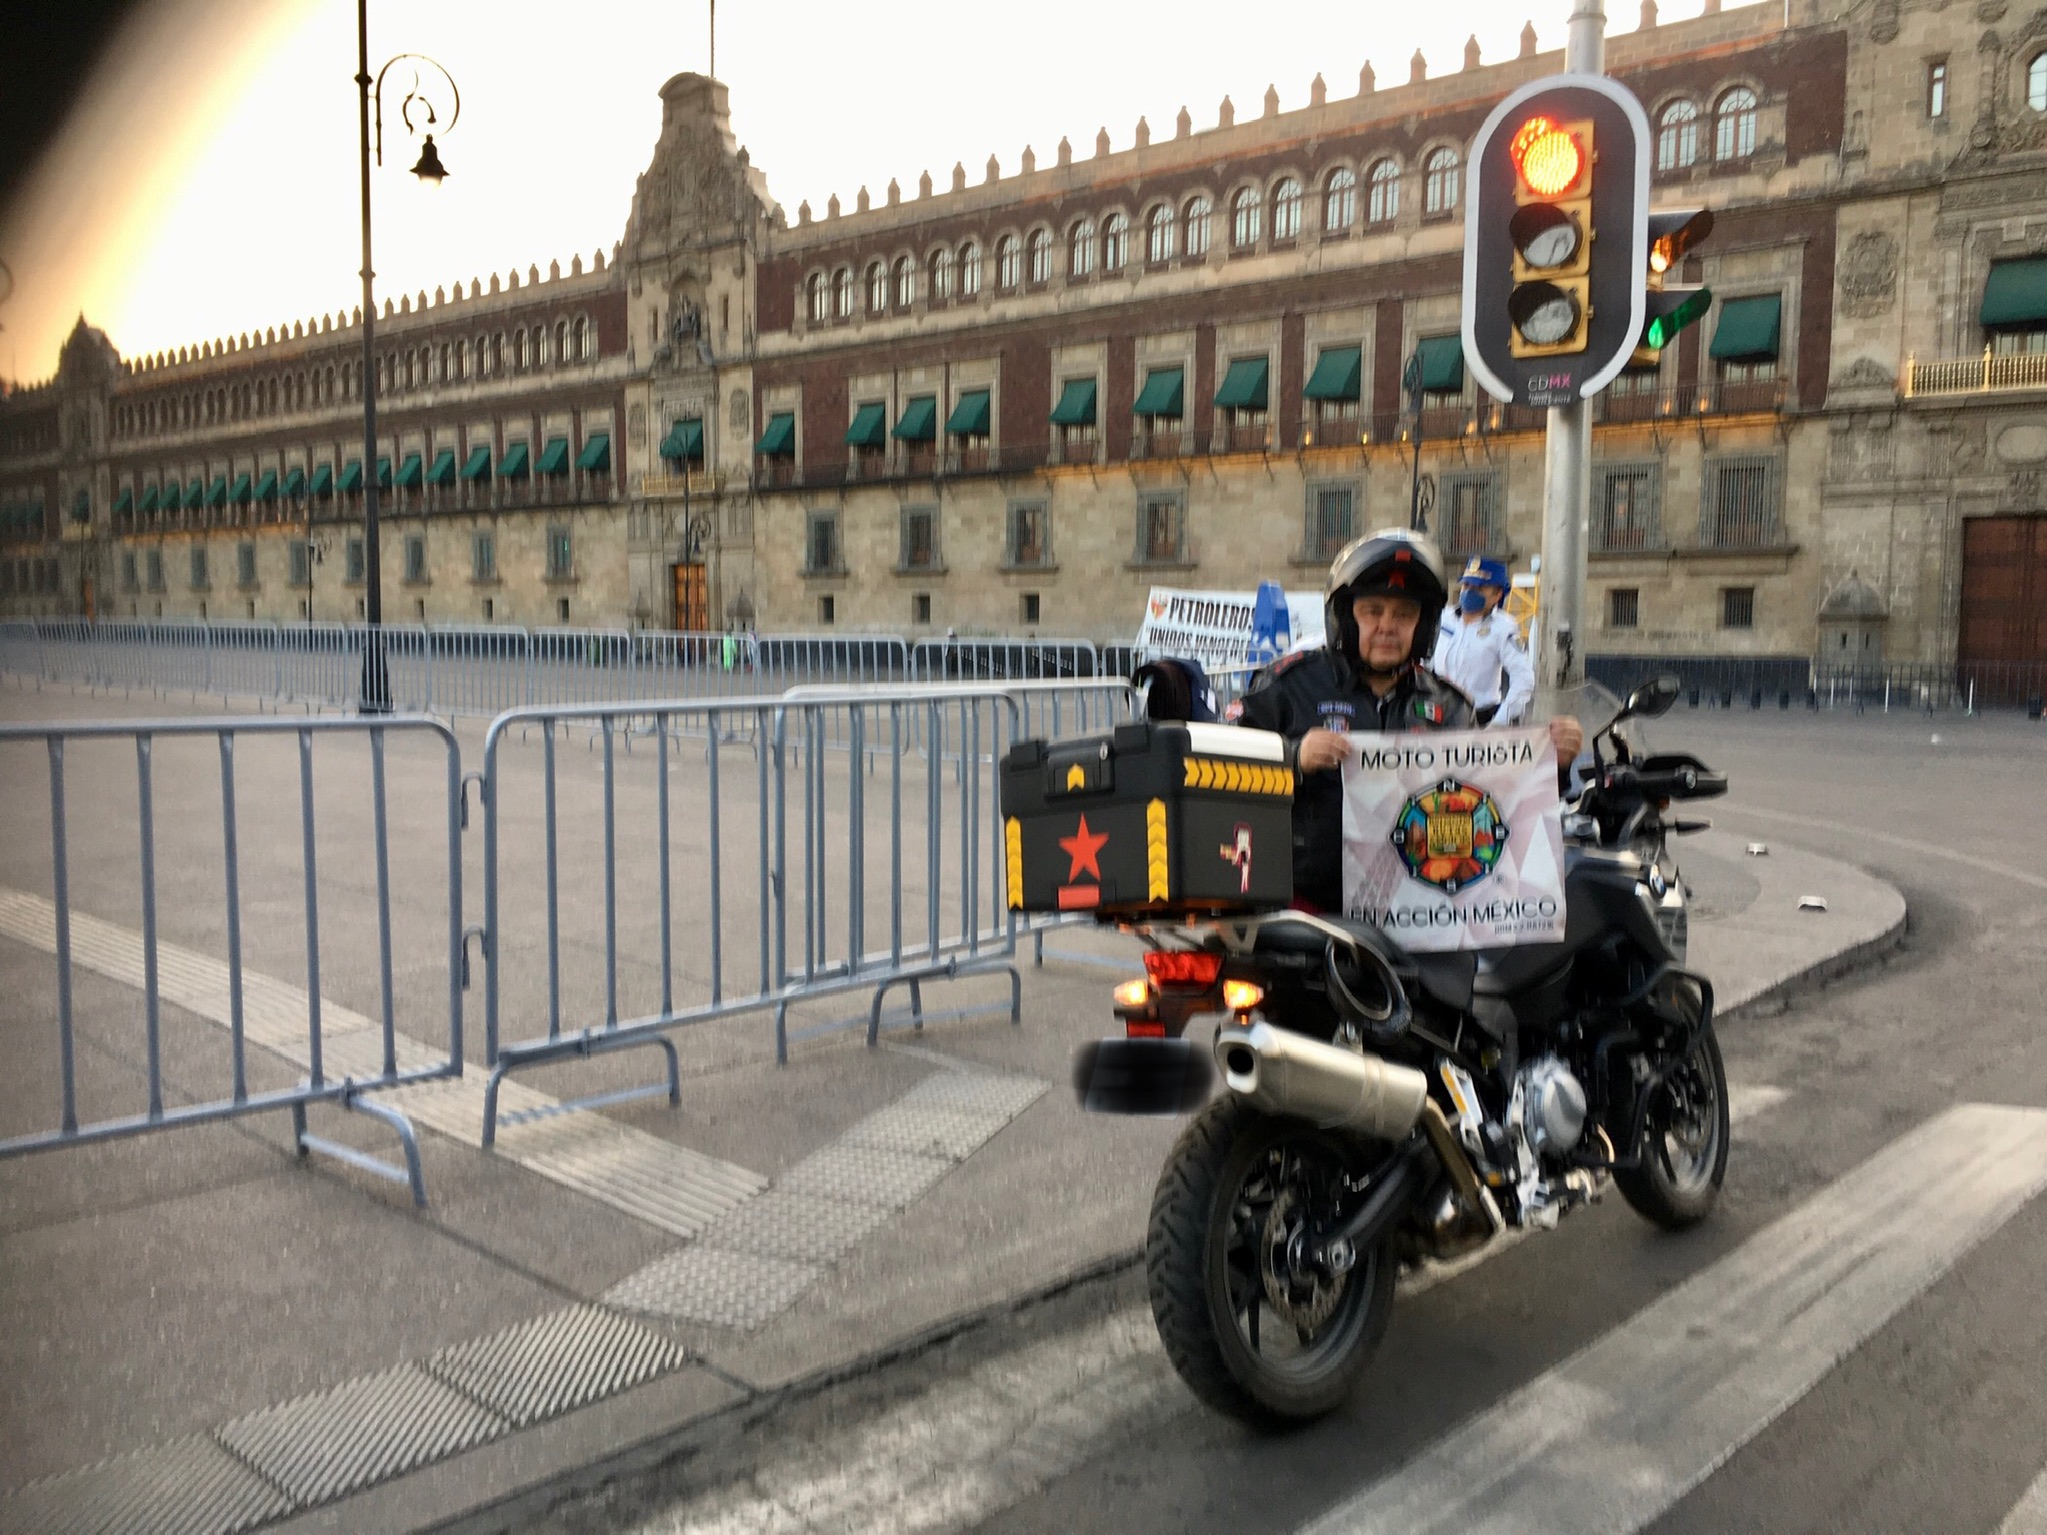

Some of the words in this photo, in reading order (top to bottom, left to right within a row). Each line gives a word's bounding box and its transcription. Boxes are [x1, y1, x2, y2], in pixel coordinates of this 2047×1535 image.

[1527, 372, 1572, 392] CDMX
[1361, 748, 1435, 771] MOTO
[1442, 740, 1533, 769] TURISTA
[1383, 902, 1468, 929] ACCIÓN
